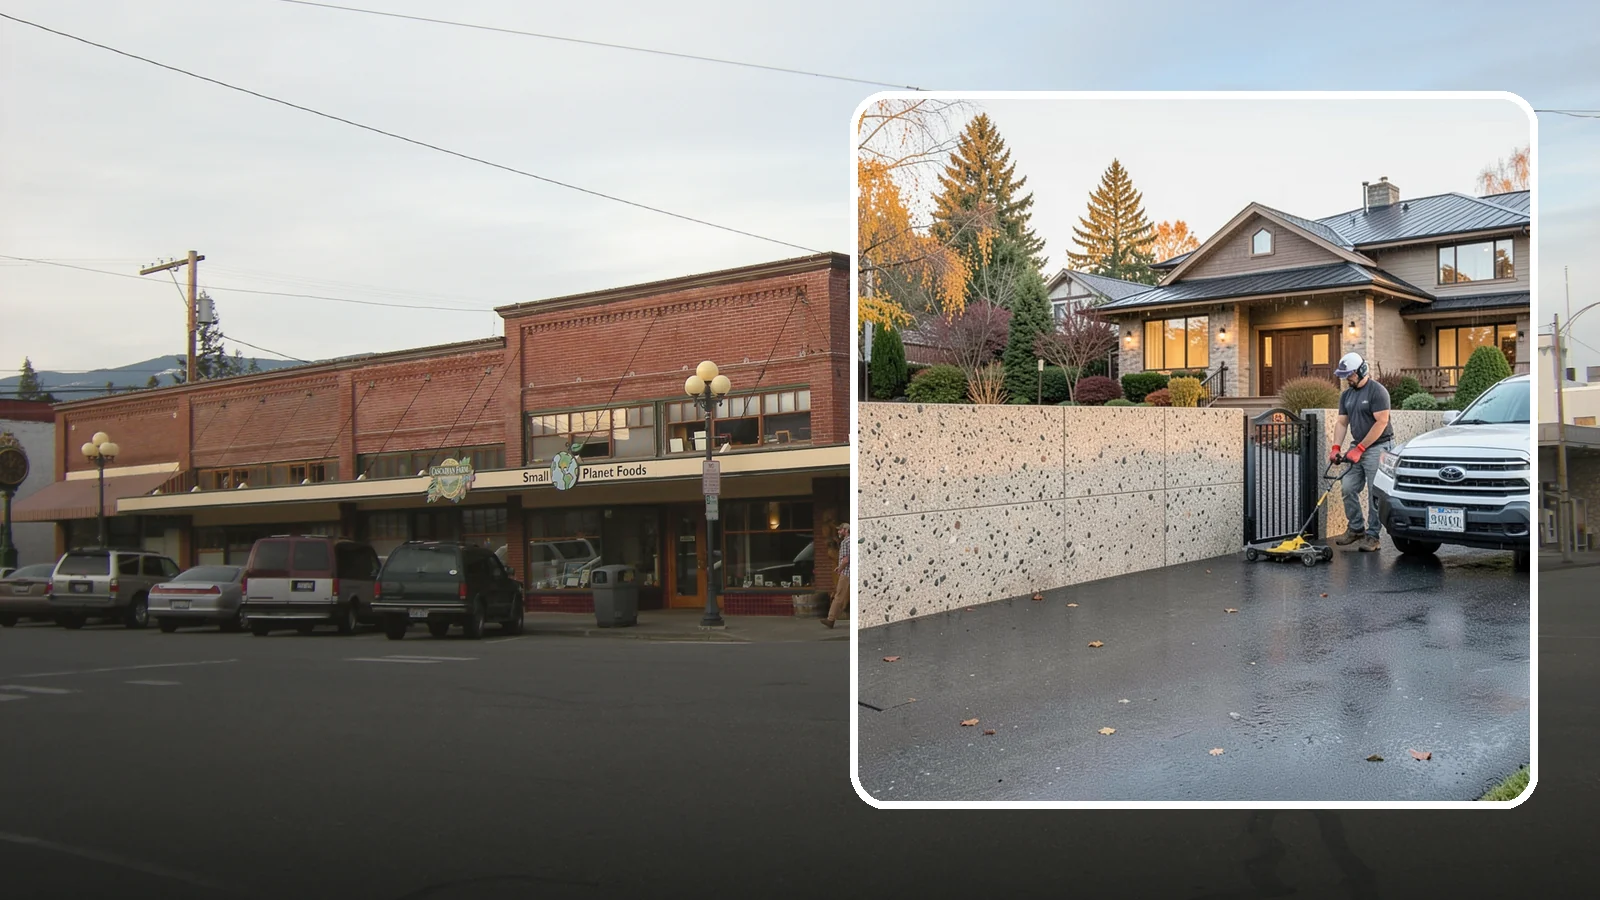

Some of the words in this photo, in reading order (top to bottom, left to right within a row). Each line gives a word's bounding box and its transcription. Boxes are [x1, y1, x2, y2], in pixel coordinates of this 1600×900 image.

[523, 470, 549, 483] Small
[583, 467, 614, 479] Planet
[617, 464, 647, 477] Foods
